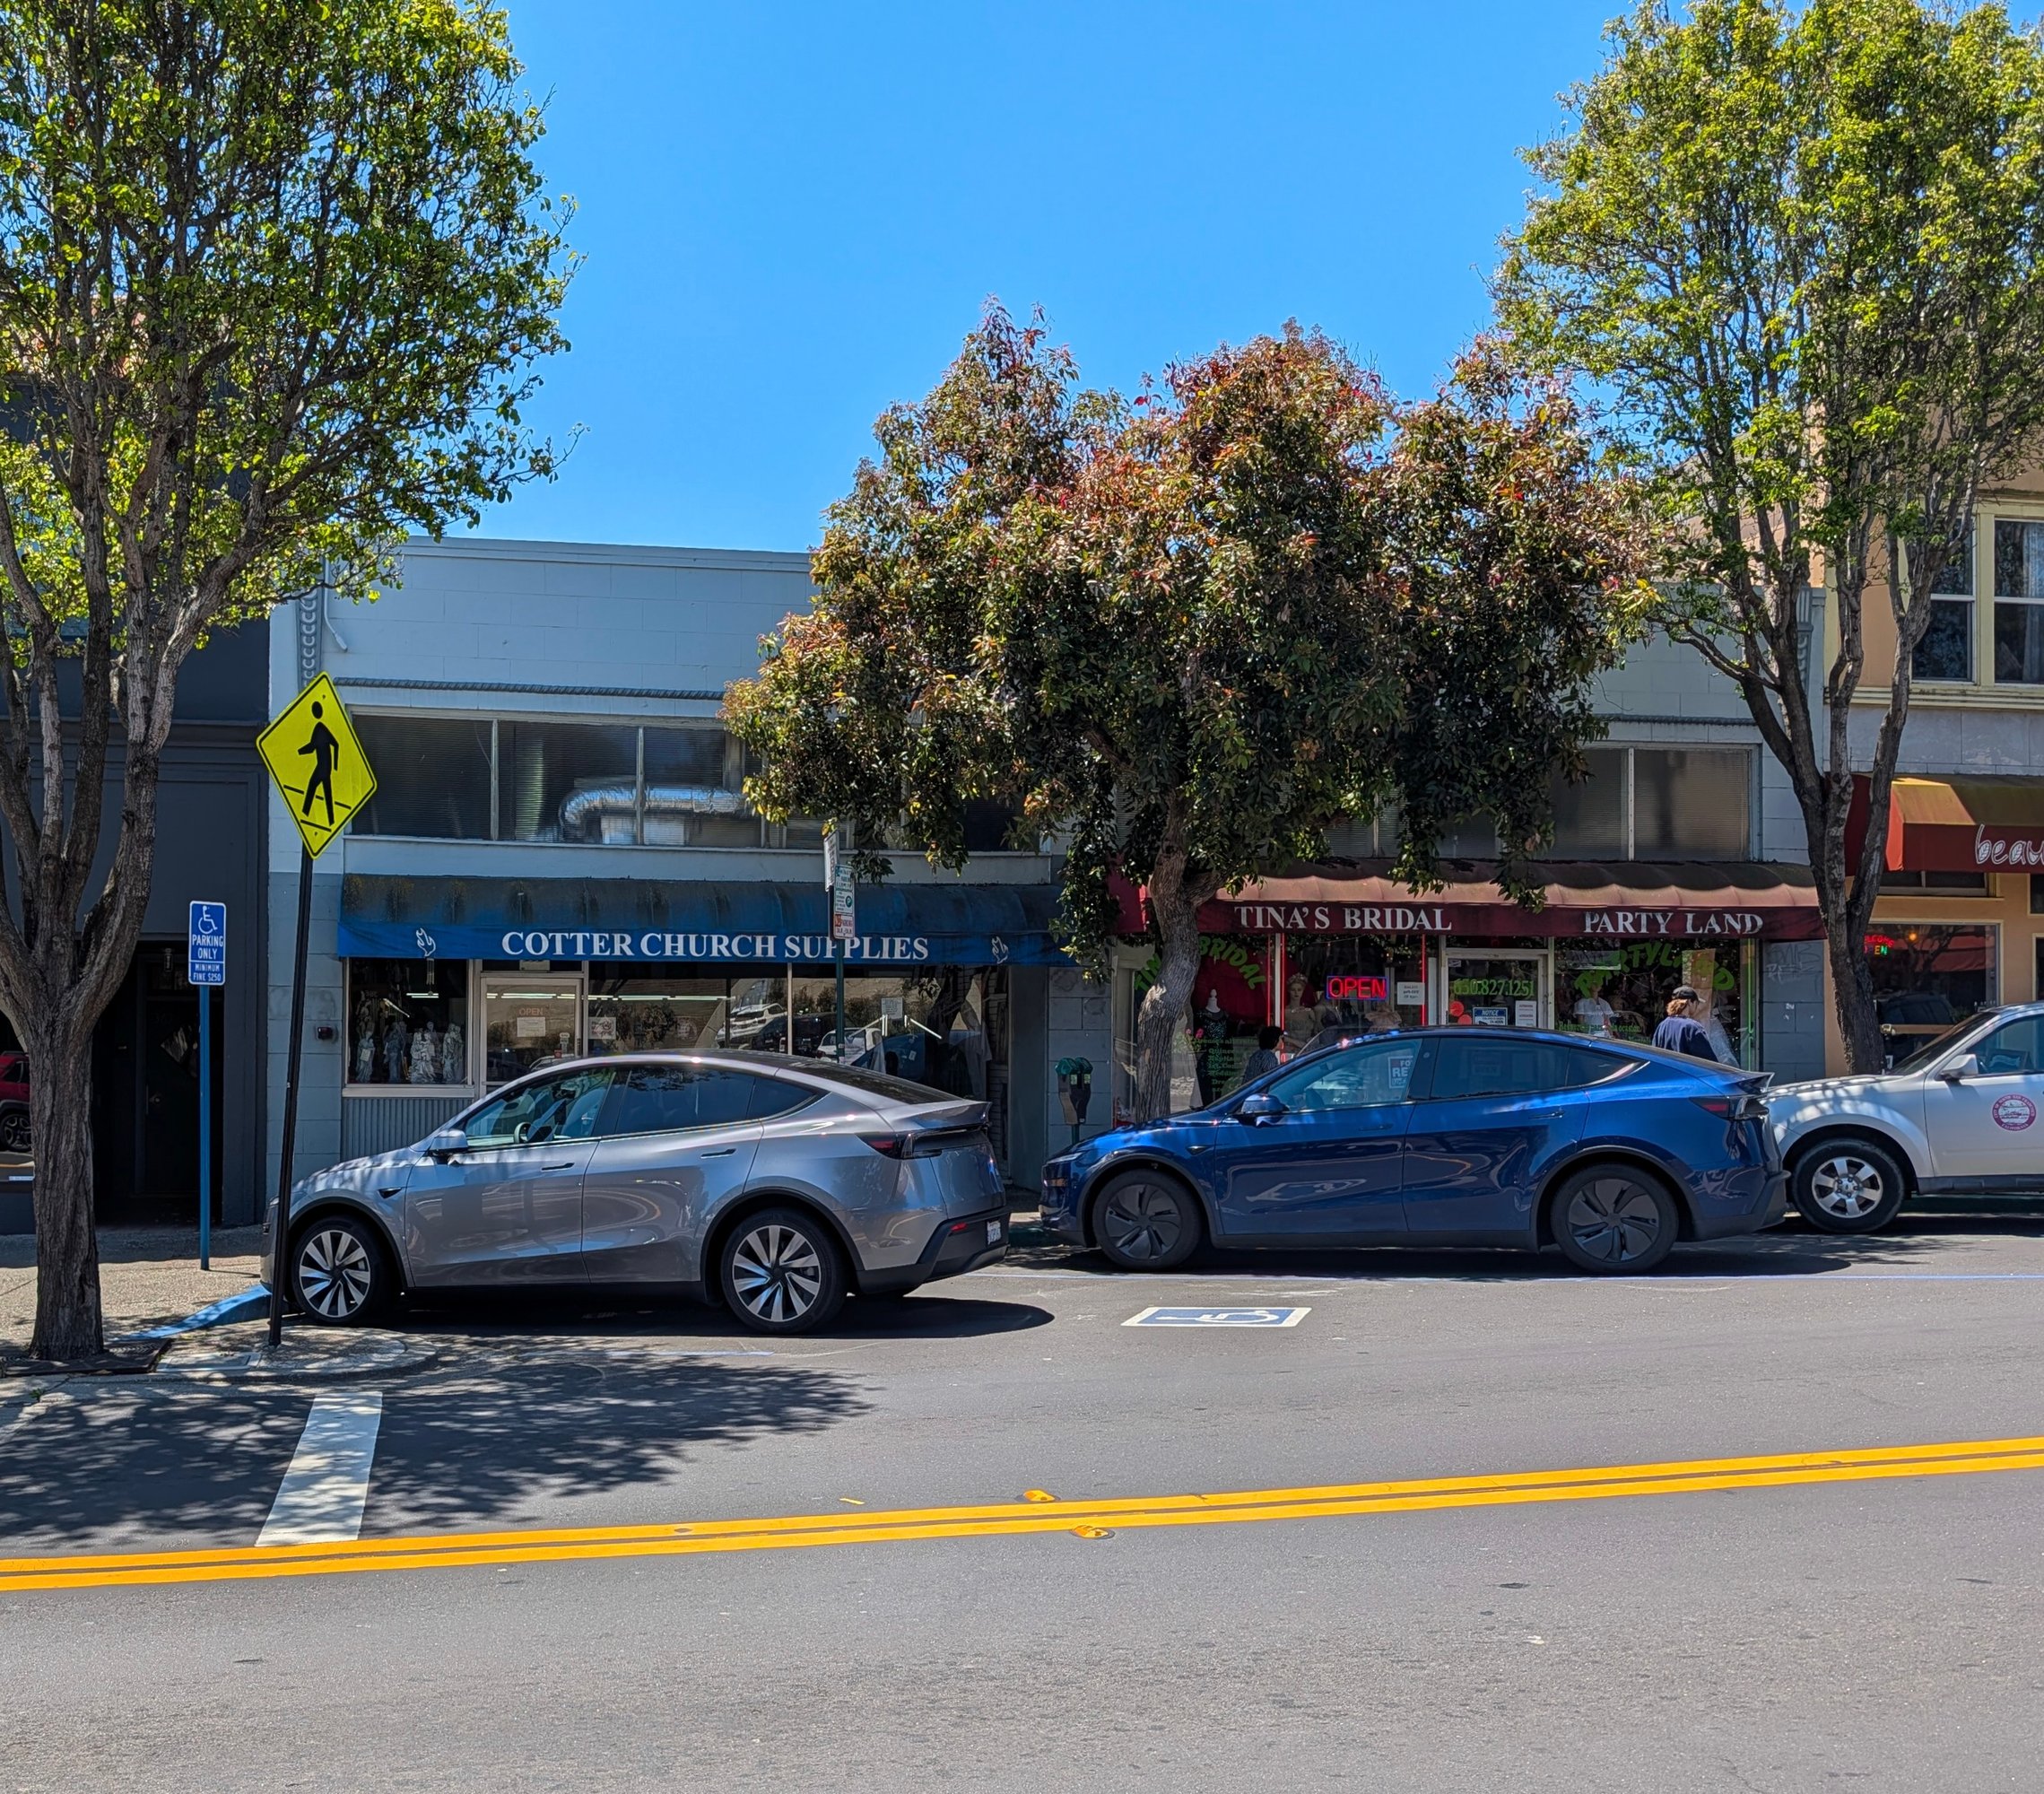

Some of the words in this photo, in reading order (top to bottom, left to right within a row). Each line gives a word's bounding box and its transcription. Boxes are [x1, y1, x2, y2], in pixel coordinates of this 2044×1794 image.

[1234, 906, 1330, 929] TINA'S
[1343, 907, 1453, 931] BRIDAL
[1583, 910, 1674, 934] PARTY
[1684, 912, 1764, 935] LAND
[192, 935, 224, 947] PARKING
[501, 931, 635, 956] COTTER
[640, 933, 777, 958] CHURCH
[785, 935, 928, 961] SUPPLIES
[197, 947, 218, 960] ONLY
[195, 962, 221, 972] MINIMUM
[1197, 936, 1266, 990] BRIDAL
[193, 972, 206, 981] FINE
[207, 972, 222, 982] $250
[1328, 977, 1387, 998] OPEN
[1453, 978, 1535, 997] 650.827.1251
[518, 1007, 544, 1016] OPEN
[1392, 1067, 1408, 1077] RE
